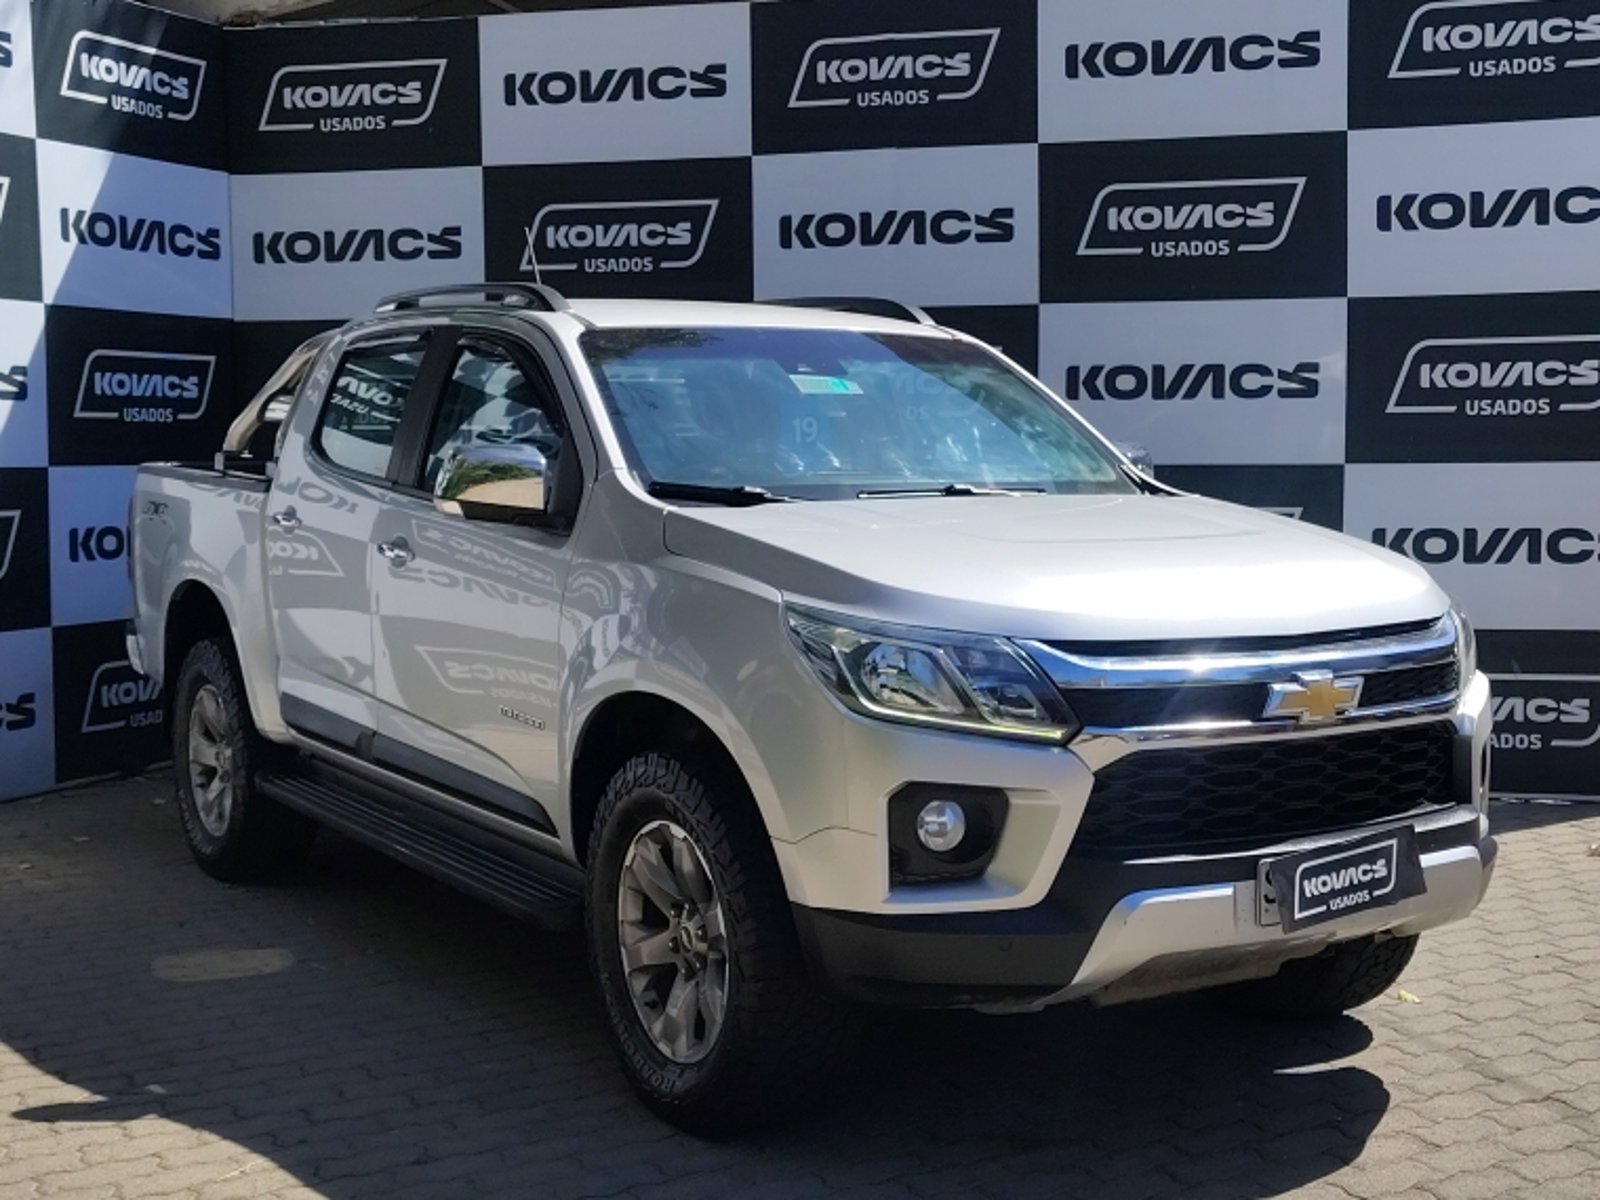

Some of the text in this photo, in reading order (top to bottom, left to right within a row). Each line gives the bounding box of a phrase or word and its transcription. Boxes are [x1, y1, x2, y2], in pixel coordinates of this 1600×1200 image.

[1422, 14, 1600, 52] KOVACS
[816, 52, 971, 84] KOVACS
[1064, 30, 1321, 79] KOVACS
[1469, 56, 1556, 77] USADOS
[81, 52, 189, 99] KOVACS
[503, 63, 727, 107] KOVACS
[111, 95, 163, 119] USADOS
[283, 81, 422, 110] KOVACS
[856, 90, 930, 107] USADOS
[319, 115, 386, 132] USADOS
[779, 208, 1015, 250] KOVACS
[1107, 201, 1275, 231] KOVACS
[60, 207, 221, 261] KOVACS
[252, 226, 462, 264] KOVACS
[546, 221, 692, 249] KOVACS
[1151, 239, 1230, 258] USADOS
[584, 257, 653, 273] USADOS
[94, 371, 199, 399] KOVACS
[1065, 362, 1320, 401] KOVACS
[1420, 359, 1600, 389] KOVACS
[123, 407, 174, 423] USADOS
[1465, 398, 1551, 416] USADOS
[1372, 528, 1600, 564] KOVAC
[1303, 859, 1388, 898] KOVACS
[1329, 890, 1371, 911] USADOS
